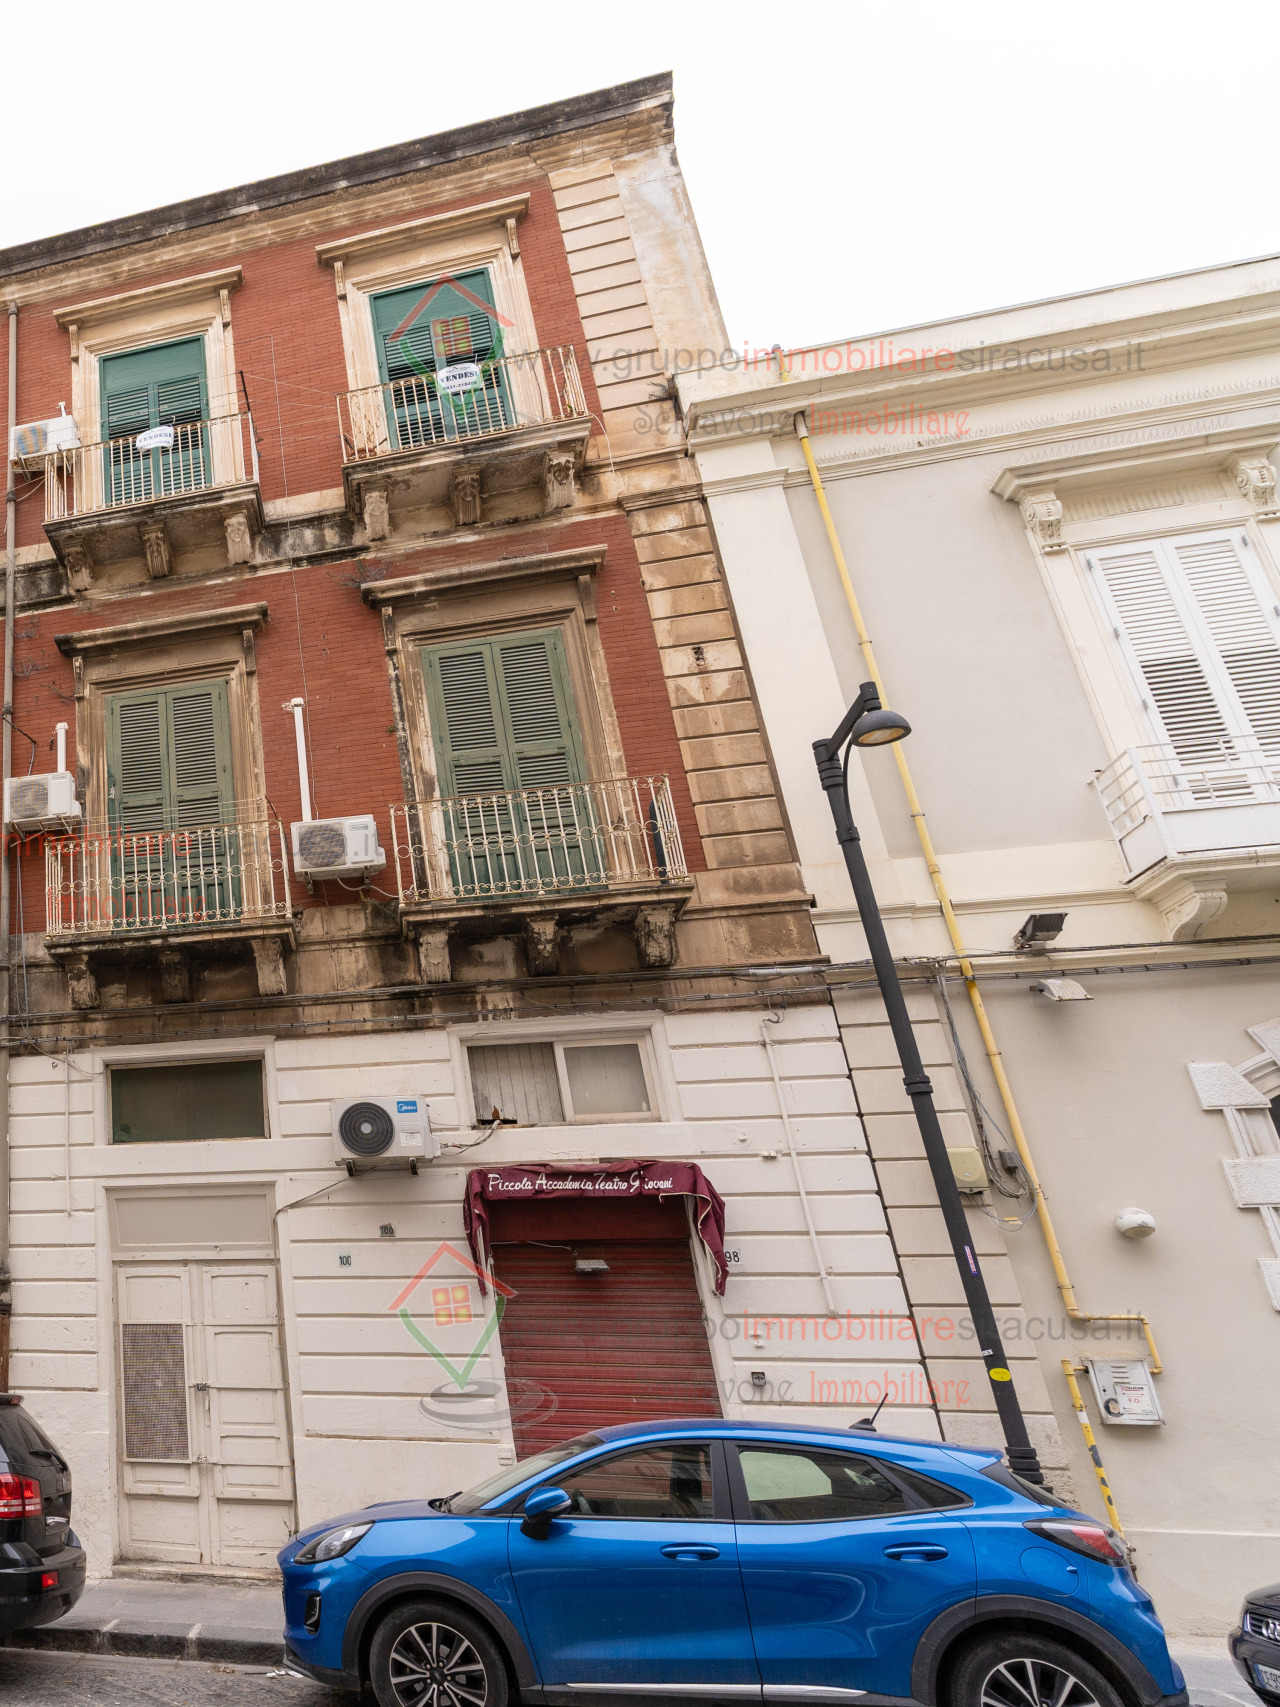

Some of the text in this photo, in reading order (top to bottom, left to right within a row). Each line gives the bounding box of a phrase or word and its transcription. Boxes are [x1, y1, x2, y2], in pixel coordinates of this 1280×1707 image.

[440, 370, 479, 384] VENDESI
[487, 1170, 674, 1193] Piccola Accademia Teatro Giovani
[380, 1226, 394, 1235] 100
[339, 1255, 352, 1266] 100
[724, 1251, 740, 1263] 98
